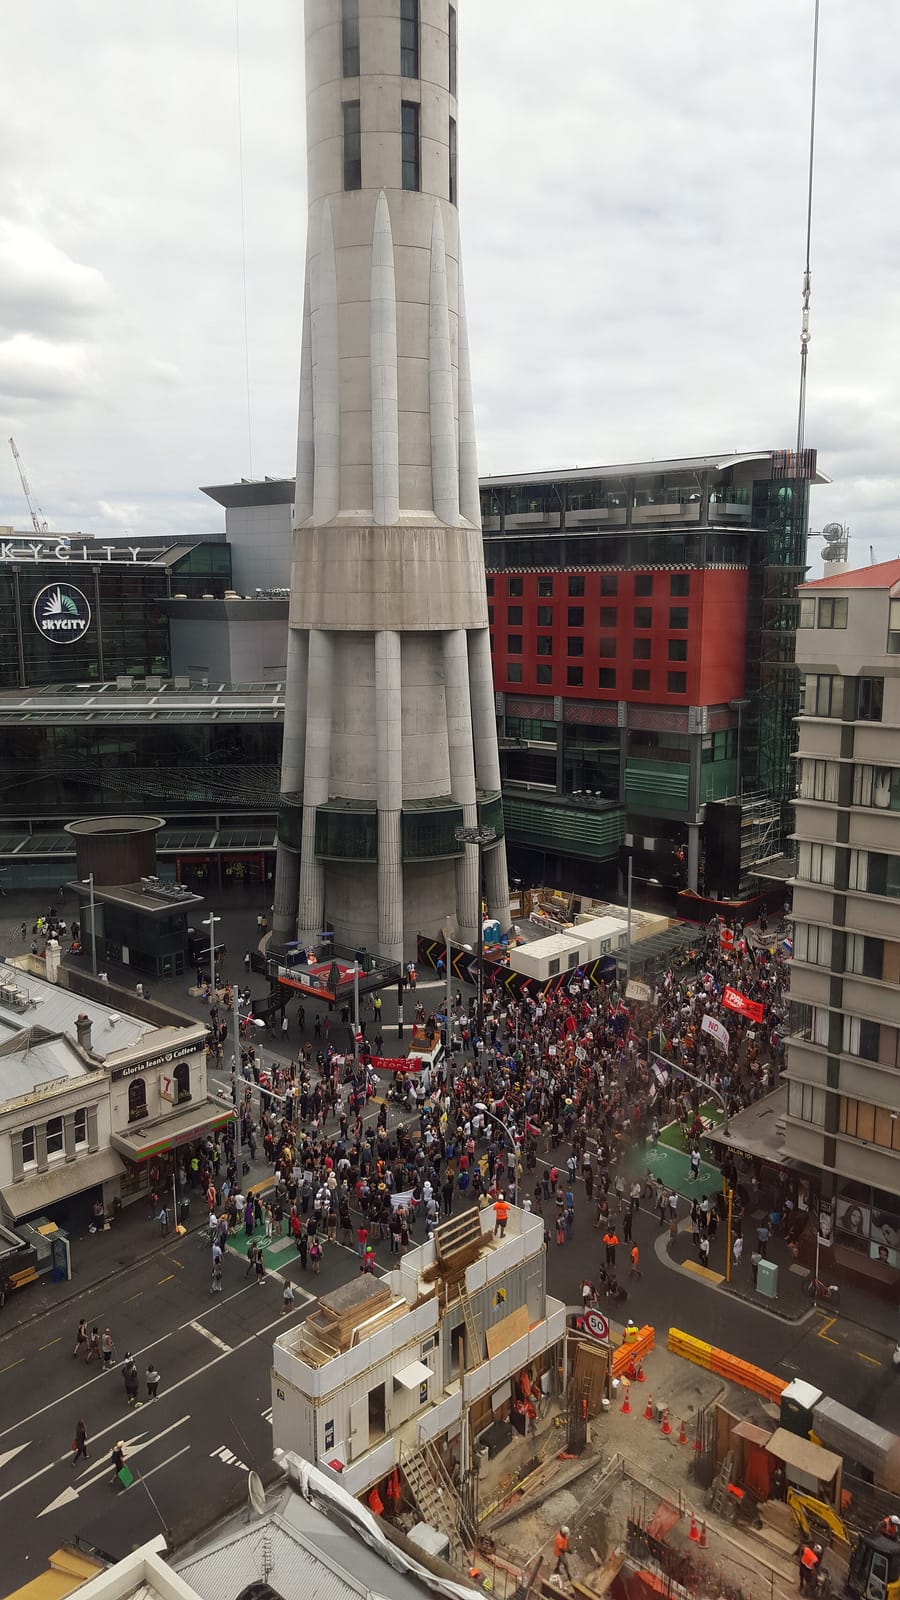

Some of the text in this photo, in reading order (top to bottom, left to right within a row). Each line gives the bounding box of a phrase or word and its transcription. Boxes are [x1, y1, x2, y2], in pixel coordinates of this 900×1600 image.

[41, 618, 86, 631] SKYCITY
[708, 1020, 719, 1032] NO
[122, 1046, 197, 1077] Gloria Jean's Coffees
[377, 1060, 415, 1070] PEOPLE
[163, 1076, 172, 1092] 7
[590, 1317, 604, 1332] 50
